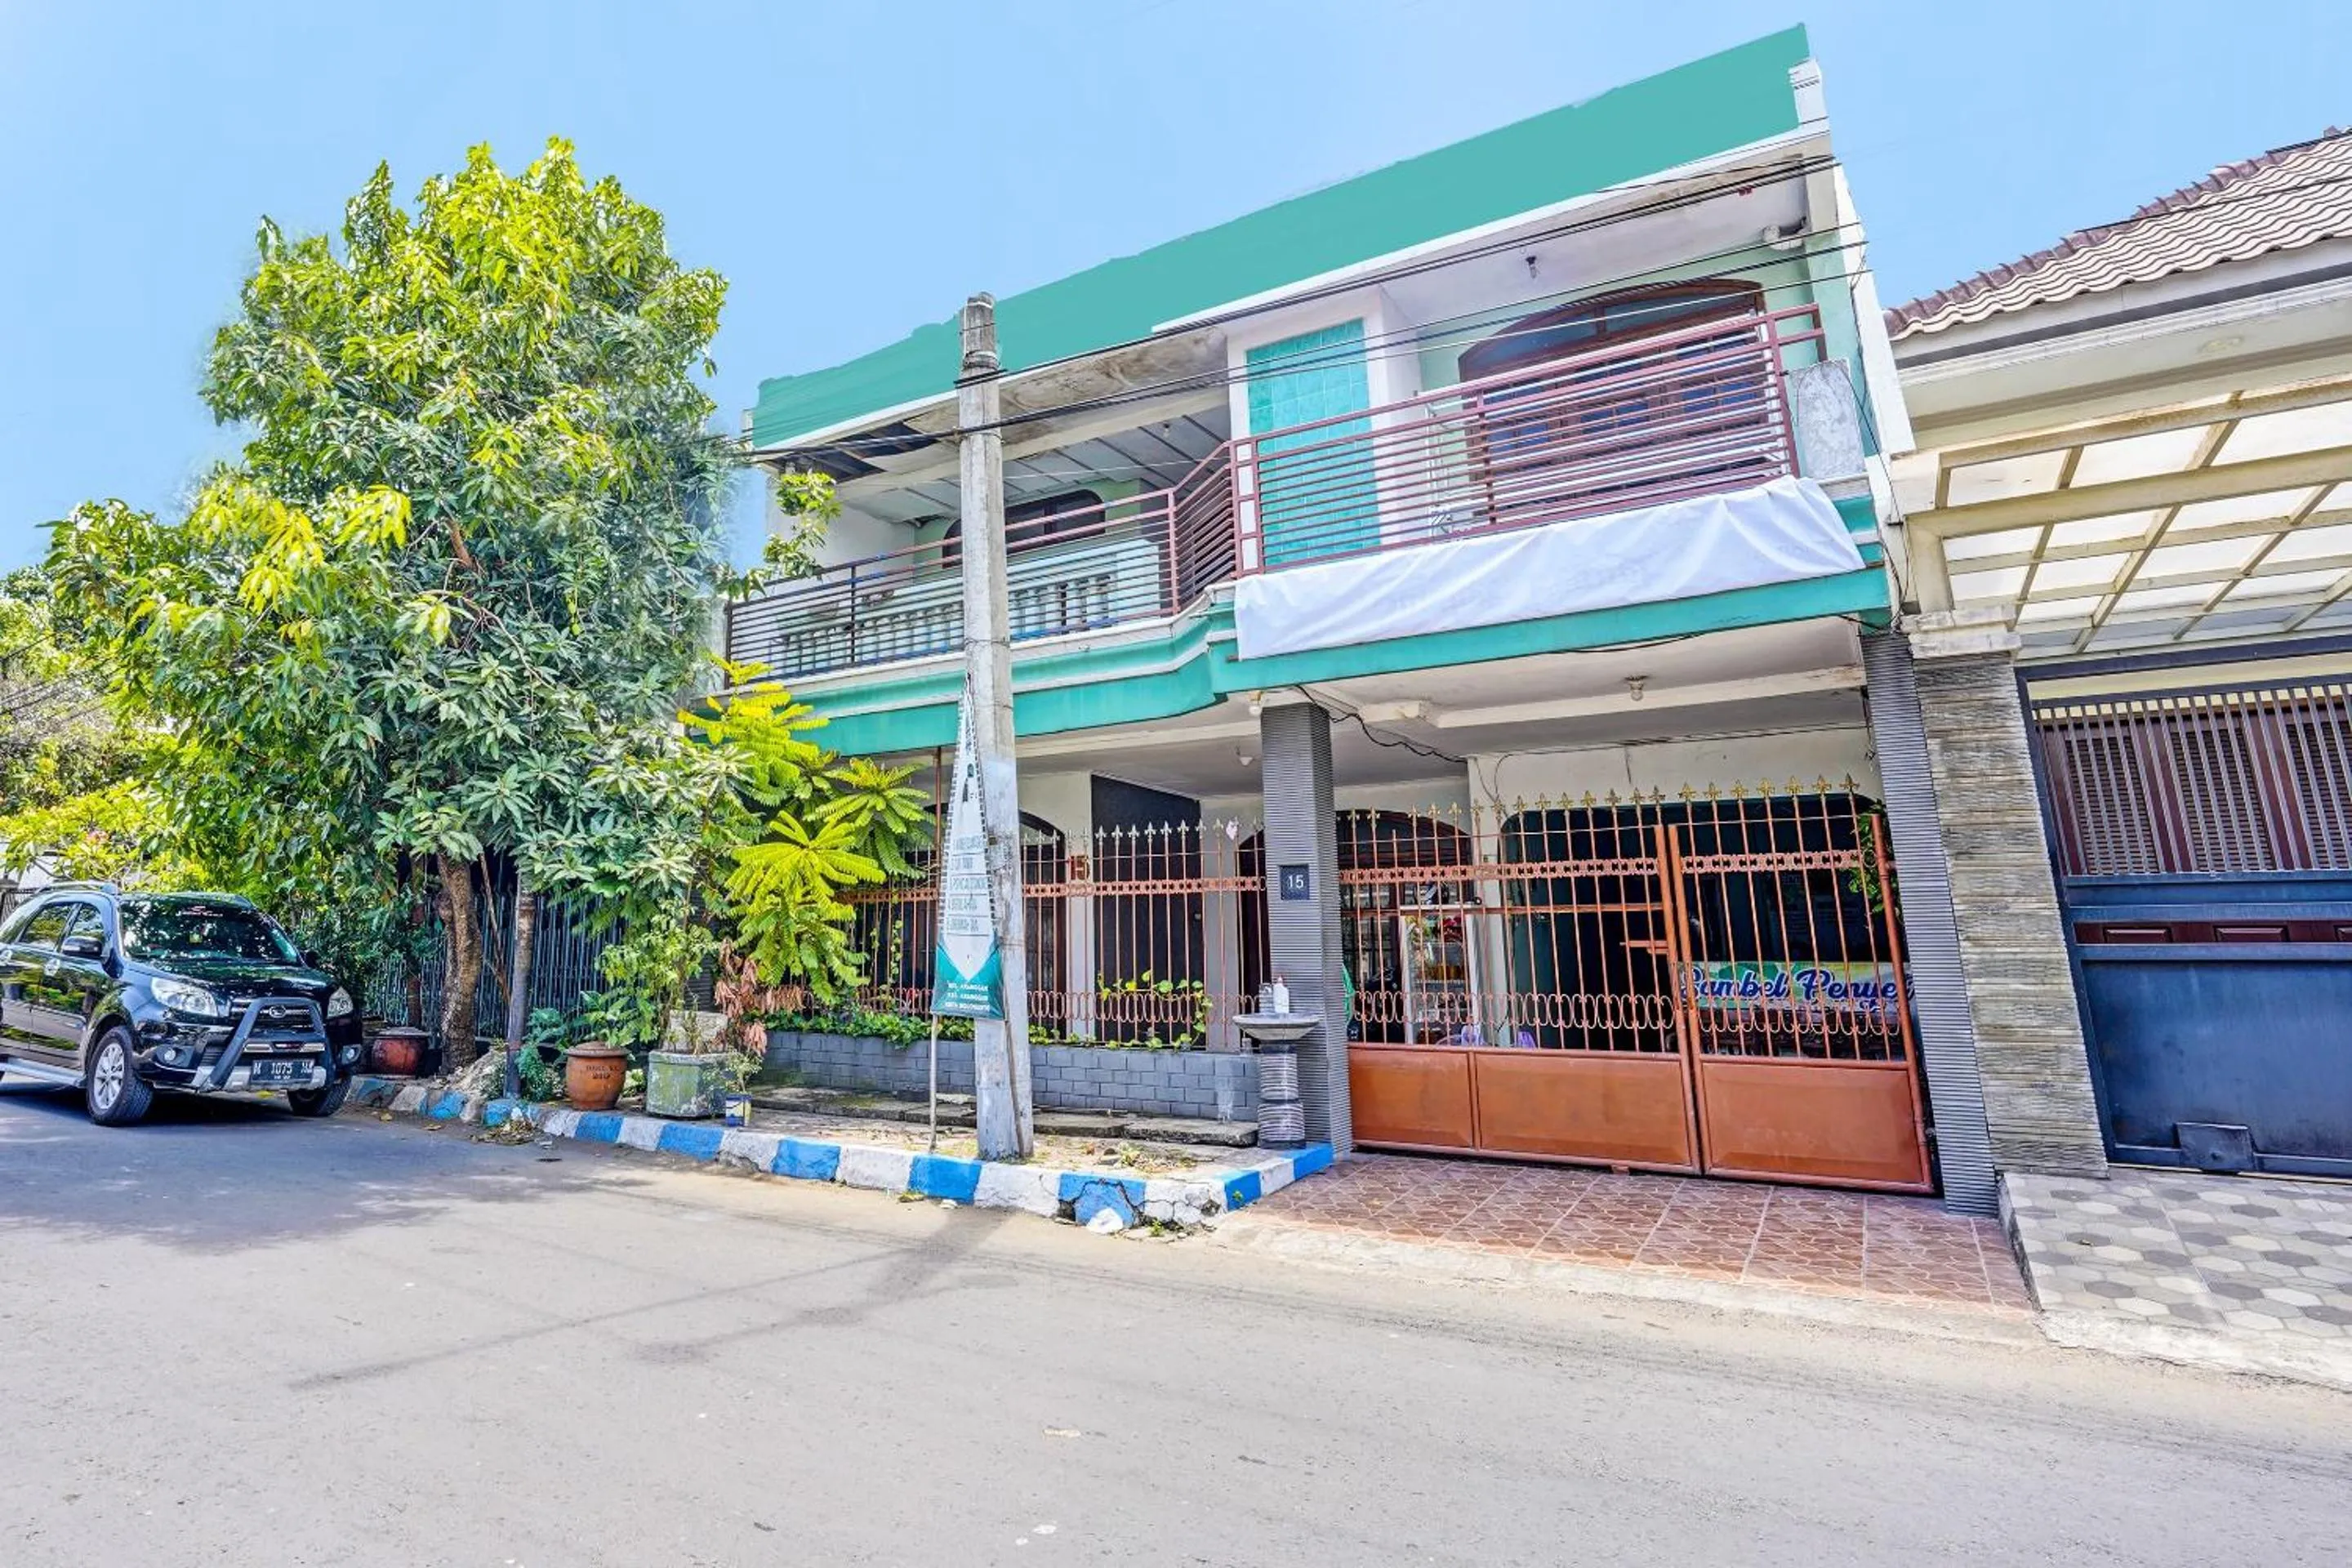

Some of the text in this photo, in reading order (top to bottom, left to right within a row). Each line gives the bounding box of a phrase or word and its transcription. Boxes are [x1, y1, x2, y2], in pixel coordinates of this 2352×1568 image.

[1288, 875, 1304, 889] 15
[1679, 967, 1790, 1000] Sambel
[270, 1062, 293, 1075] 1075
